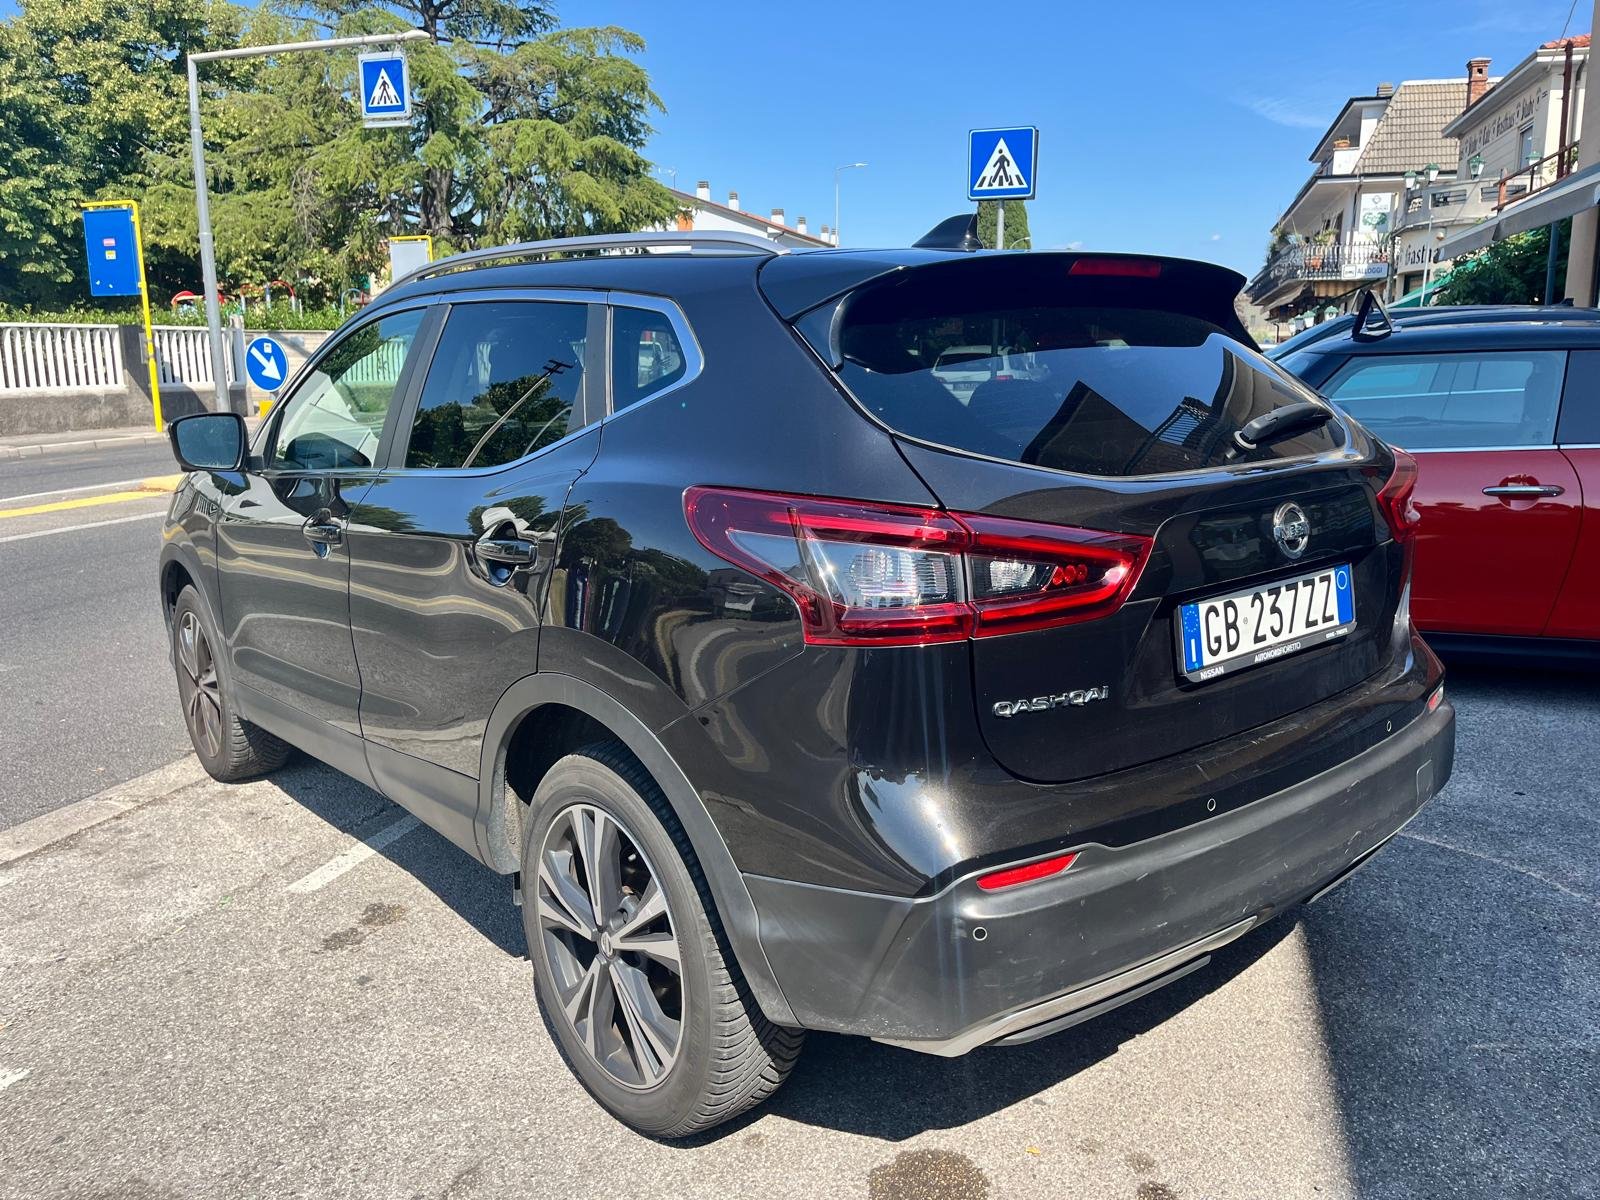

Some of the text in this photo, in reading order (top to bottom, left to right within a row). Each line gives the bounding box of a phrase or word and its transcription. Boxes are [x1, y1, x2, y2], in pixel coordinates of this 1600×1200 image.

[1357, 266, 1383, 275] ALLOGGI
[1204, 600, 1240, 657] GB
[1250, 574, 1335, 645] 237ZZ
[1200, 666, 1225, 681] NISSAN
[992, 685, 1109, 718] QASHQAI
